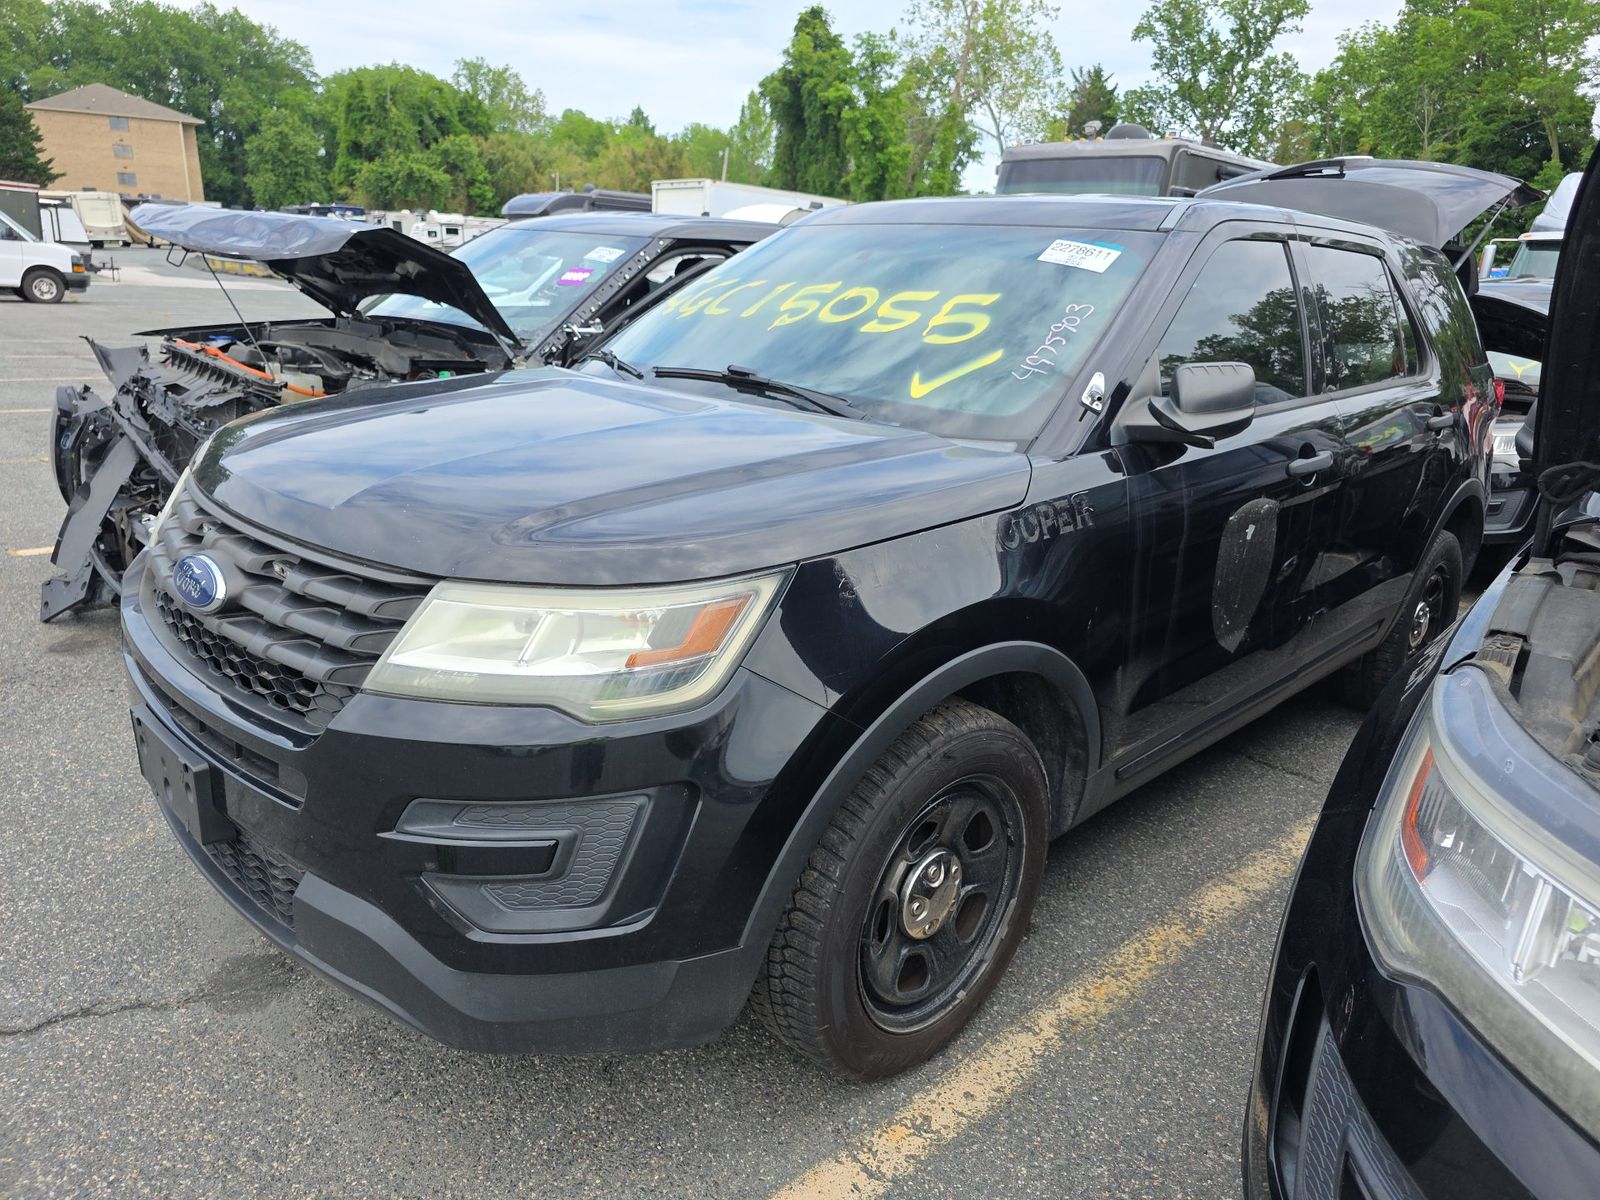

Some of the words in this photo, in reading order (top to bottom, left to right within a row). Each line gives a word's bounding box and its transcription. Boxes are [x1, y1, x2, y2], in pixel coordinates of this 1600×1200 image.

[1051, 242, 1112, 260] 2278611
[1011, 303, 1095, 380] 4975903
[176, 560, 206, 599] Ford
